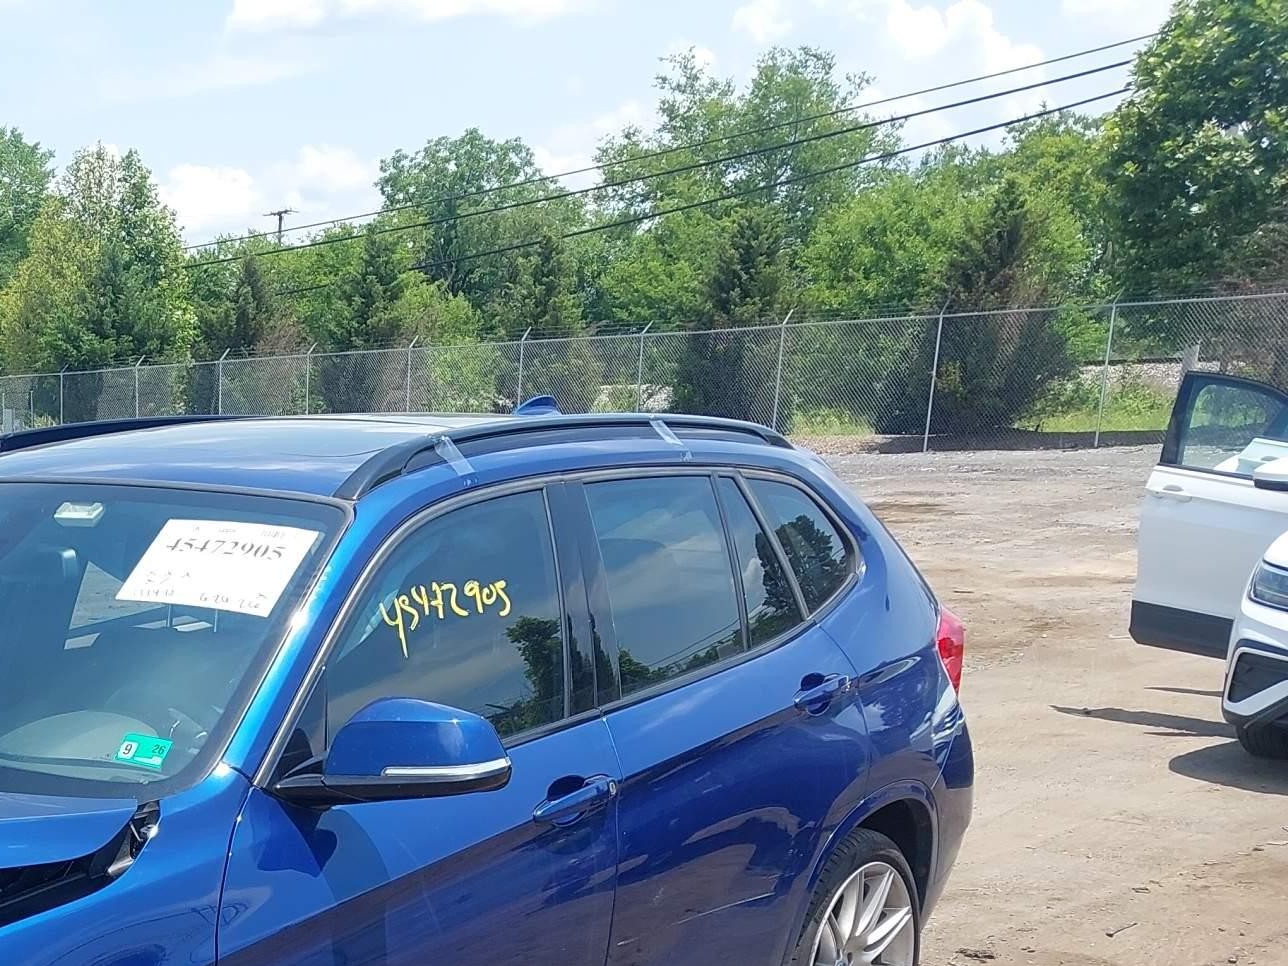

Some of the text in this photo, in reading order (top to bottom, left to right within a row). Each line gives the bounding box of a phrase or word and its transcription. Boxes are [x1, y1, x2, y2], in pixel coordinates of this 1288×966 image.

[166, 536, 288, 561] 45472905
[378, 578, 512, 659] 45472905
[122, 743, 167, 755] 9 26
